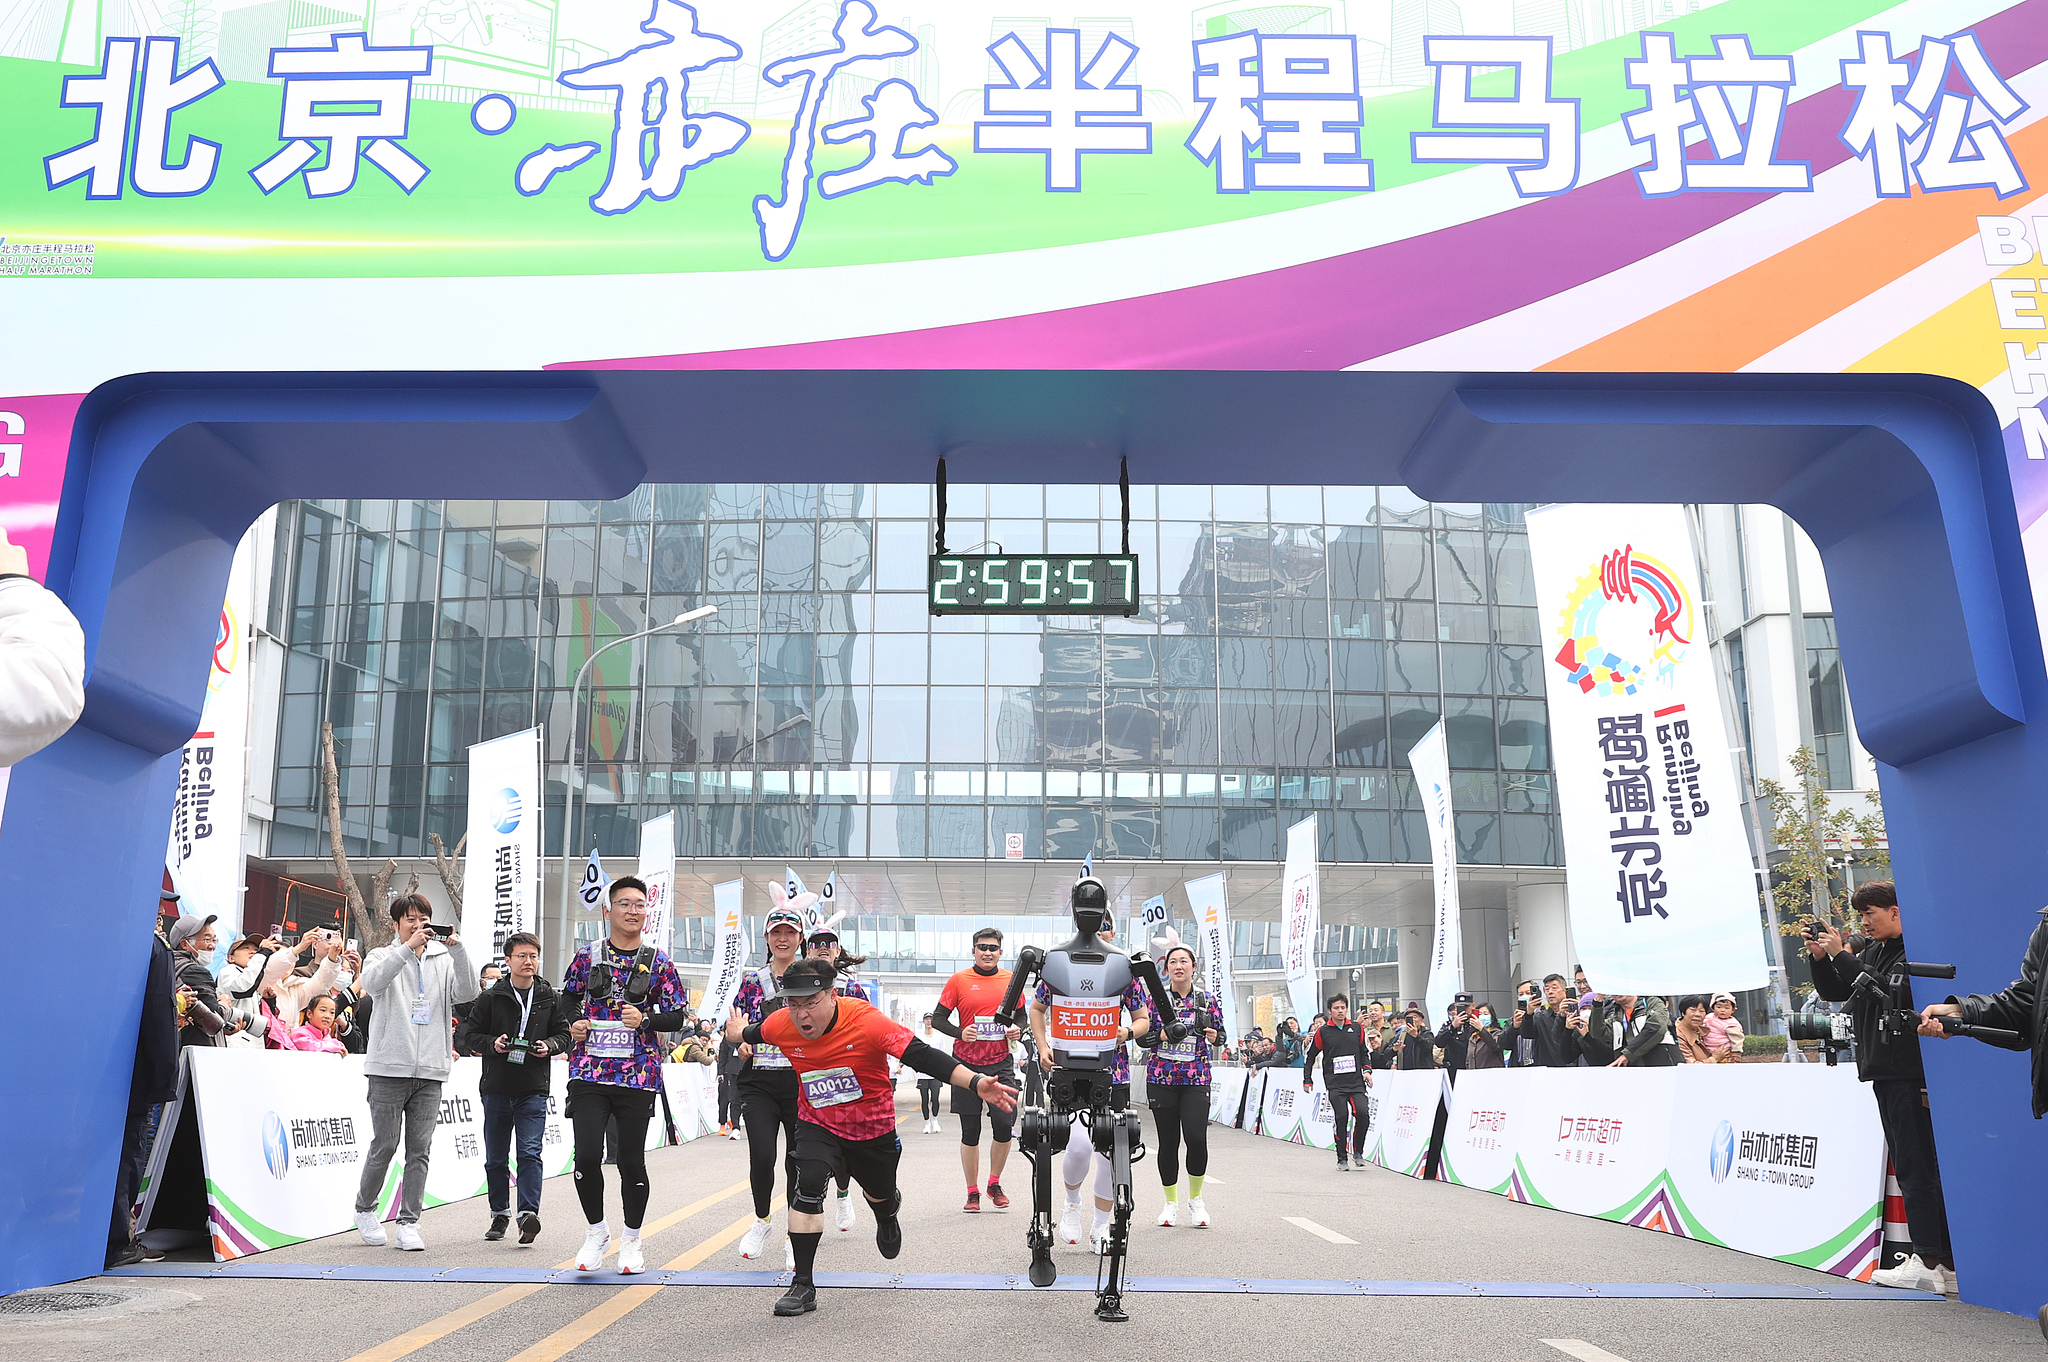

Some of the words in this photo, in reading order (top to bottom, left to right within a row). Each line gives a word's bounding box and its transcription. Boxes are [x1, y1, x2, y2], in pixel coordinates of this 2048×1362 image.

[1, 244, 95, 254] 北京亦庄半程马拉松
[29, 266, 92, 275] MARATHON
[1990, 278, 2048, 329] E
[934, 559, 1133, 605] 2:59:57
[1058, 1011, 1087, 1027] 天工
[1090, 1013, 1114, 1026] 001
[588, 1030, 629, 1044] A7259
[1064, 1028, 1083, 1037] TIEN
[1085, 1029, 1108, 1037] KUNG
[808, 1078, 853, 1096] A0012
[291, 1117, 356, 1149] 尚亦城集团
[1574, 1116, 1623, 1145] 京东超市
[1739, 1130, 1818, 1169] 尚亦城集团
[296, 1154, 317, 1168] SHANG
[340, 1150, 358, 1163] GROUP
[1737, 1166, 1759, 1181] SHANG
[1762, 1169, 1788, 1186] E-TOWN
[1789, 1173, 1815, 1189] GROUP
